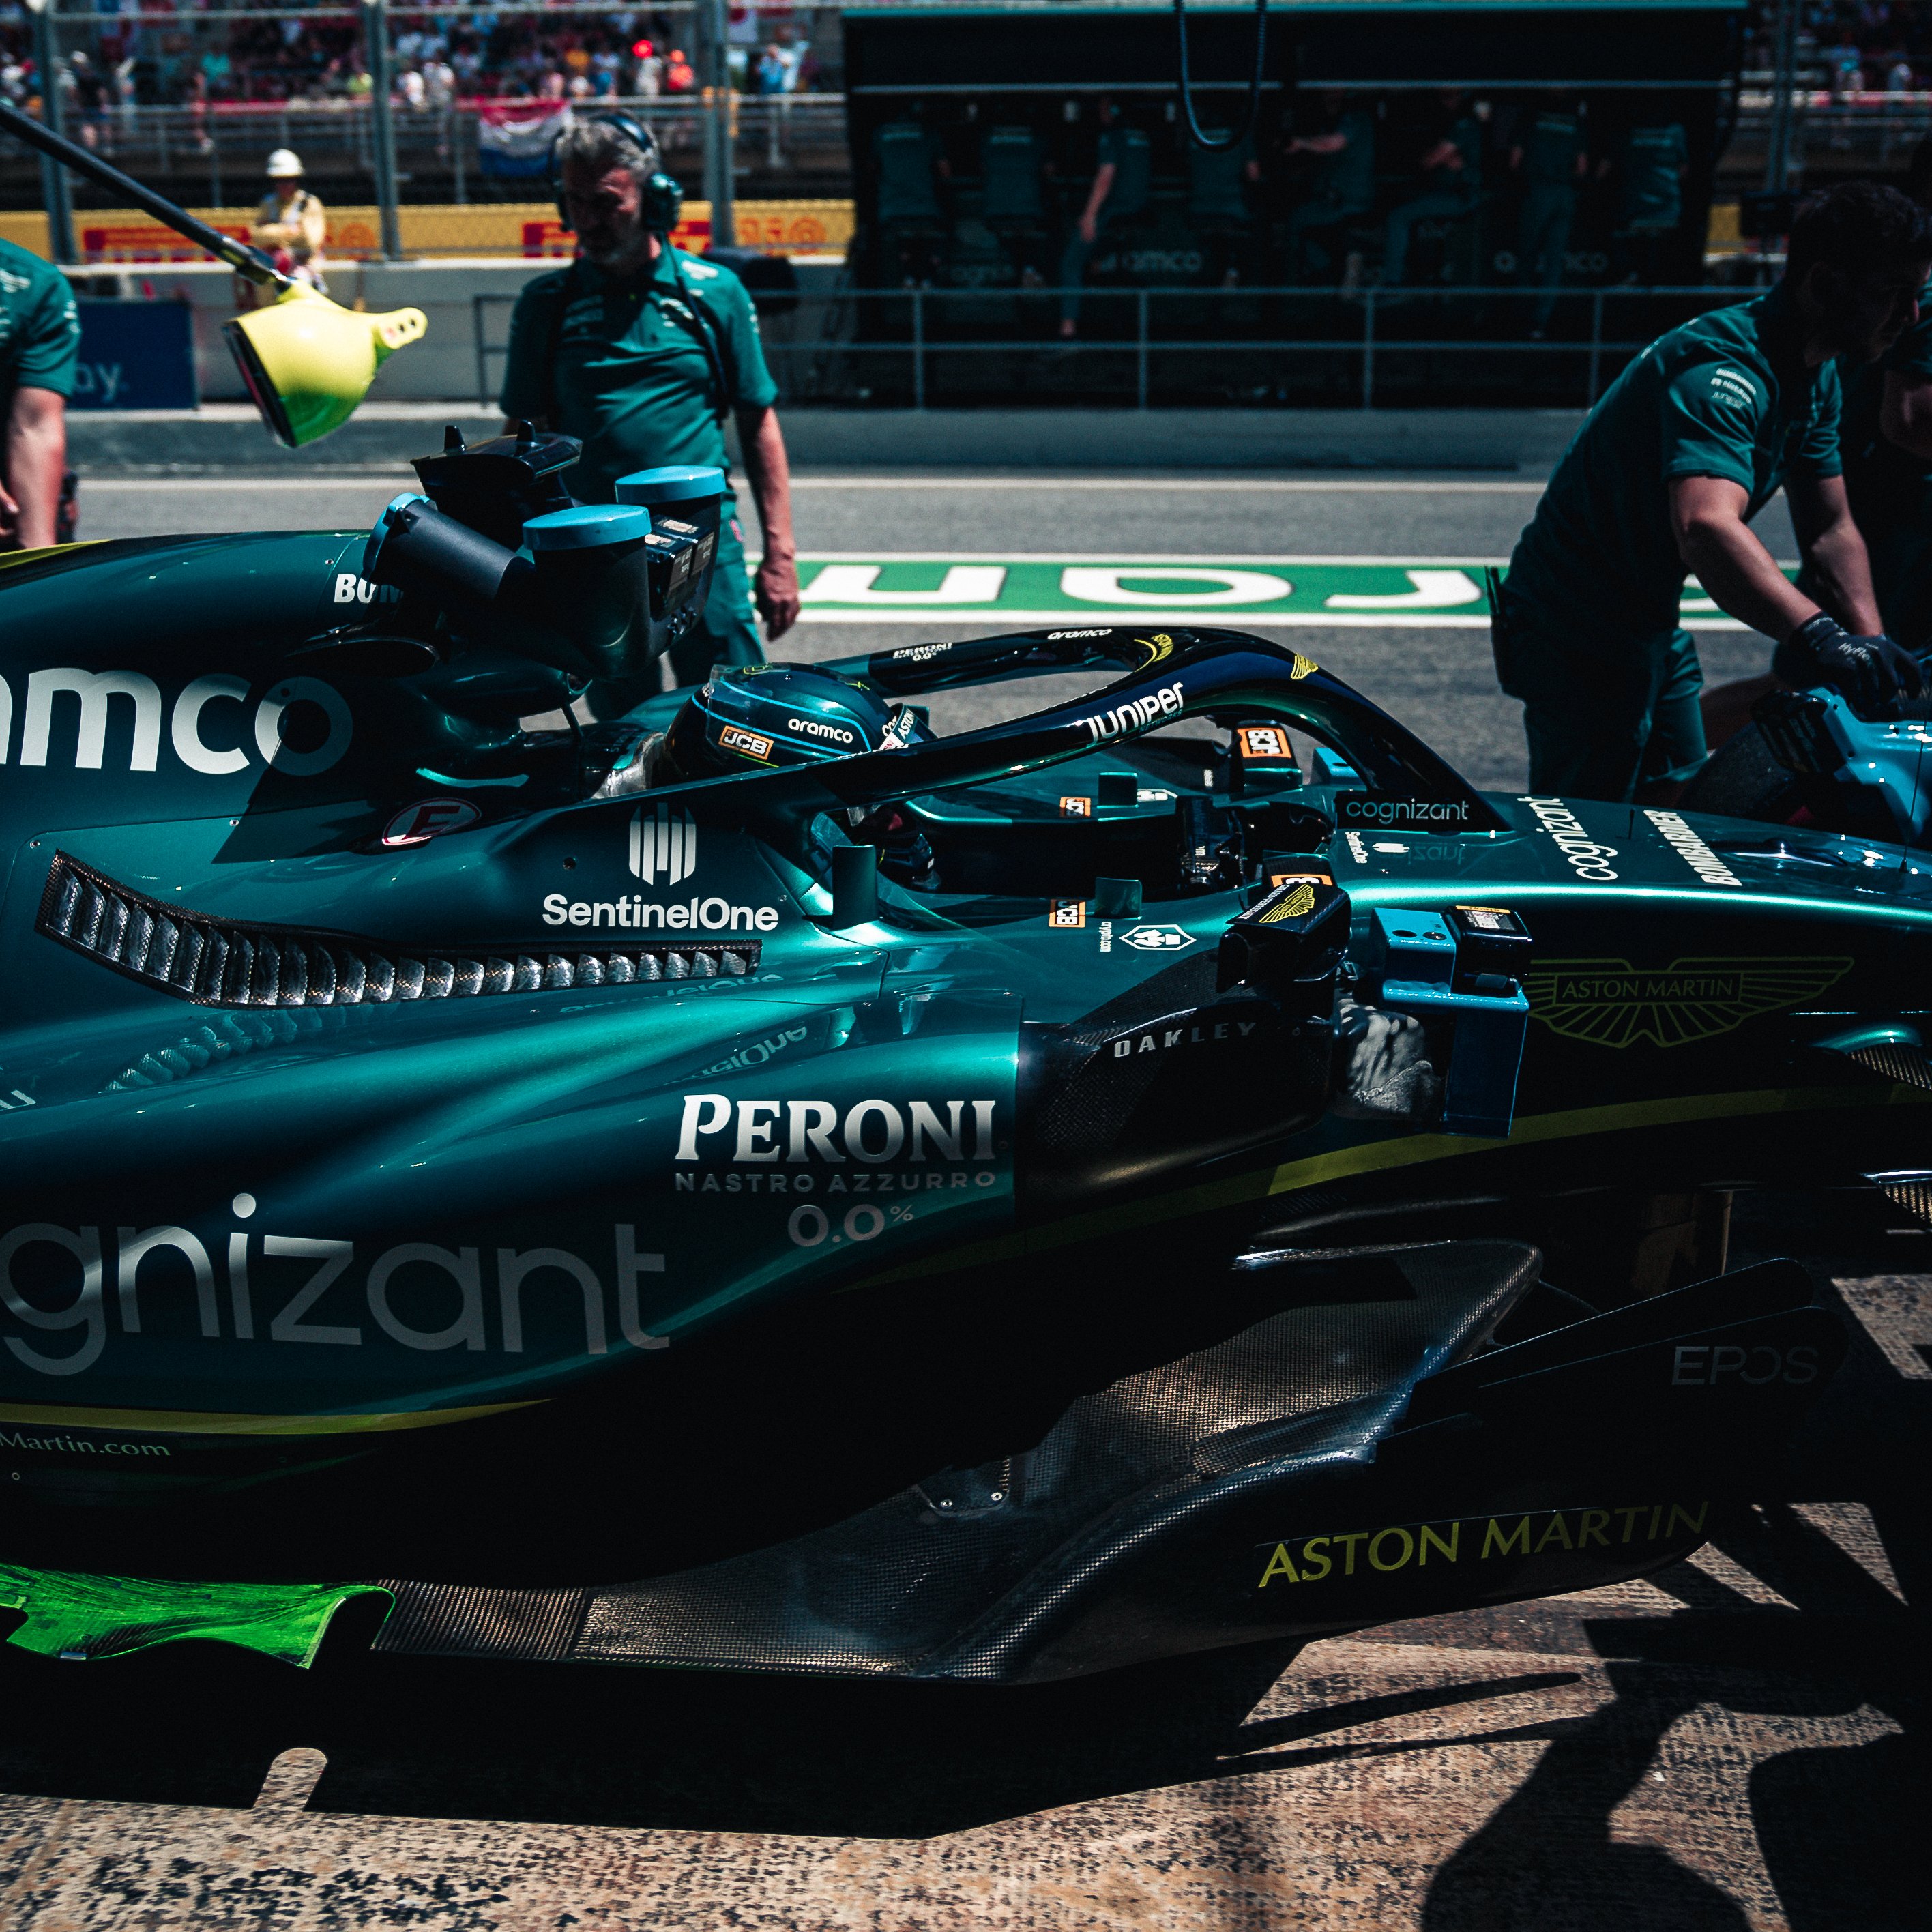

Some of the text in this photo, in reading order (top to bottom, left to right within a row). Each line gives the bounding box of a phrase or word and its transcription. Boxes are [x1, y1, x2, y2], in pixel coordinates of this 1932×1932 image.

[1047, 628, 1113, 640] aramco
[892, 642, 953, 660] PERONI
[0, 667, 353, 776] mco
[787, 718, 853, 744] aramco
[724, 732, 768, 756] JCB
[1248, 729, 1280, 754] JCB
[1346, 797, 1470, 825] cognizant
[1517, 796, 1618, 881] cognizant
[1643, 809, 1743, 887] BOMBARDIER
[542, 893, 780, 931] SentinelOne
[1057, 900, 1079, 926] JCB
[1562, 974, 1733, 999] ASTON MARTIN
[1113, 1022, 1258, 1059] OAKLEY
[674, 1094, 997, 1164] PERONI
[675, 1171, 997, 1193] NASTRO AZZURRO
[787, 1204, 914, 1248] 0.0%
[1671, 1345, 1819, 1386] EPOS
[1258, 1501, 1710, 1588] ASTON MARTIN
